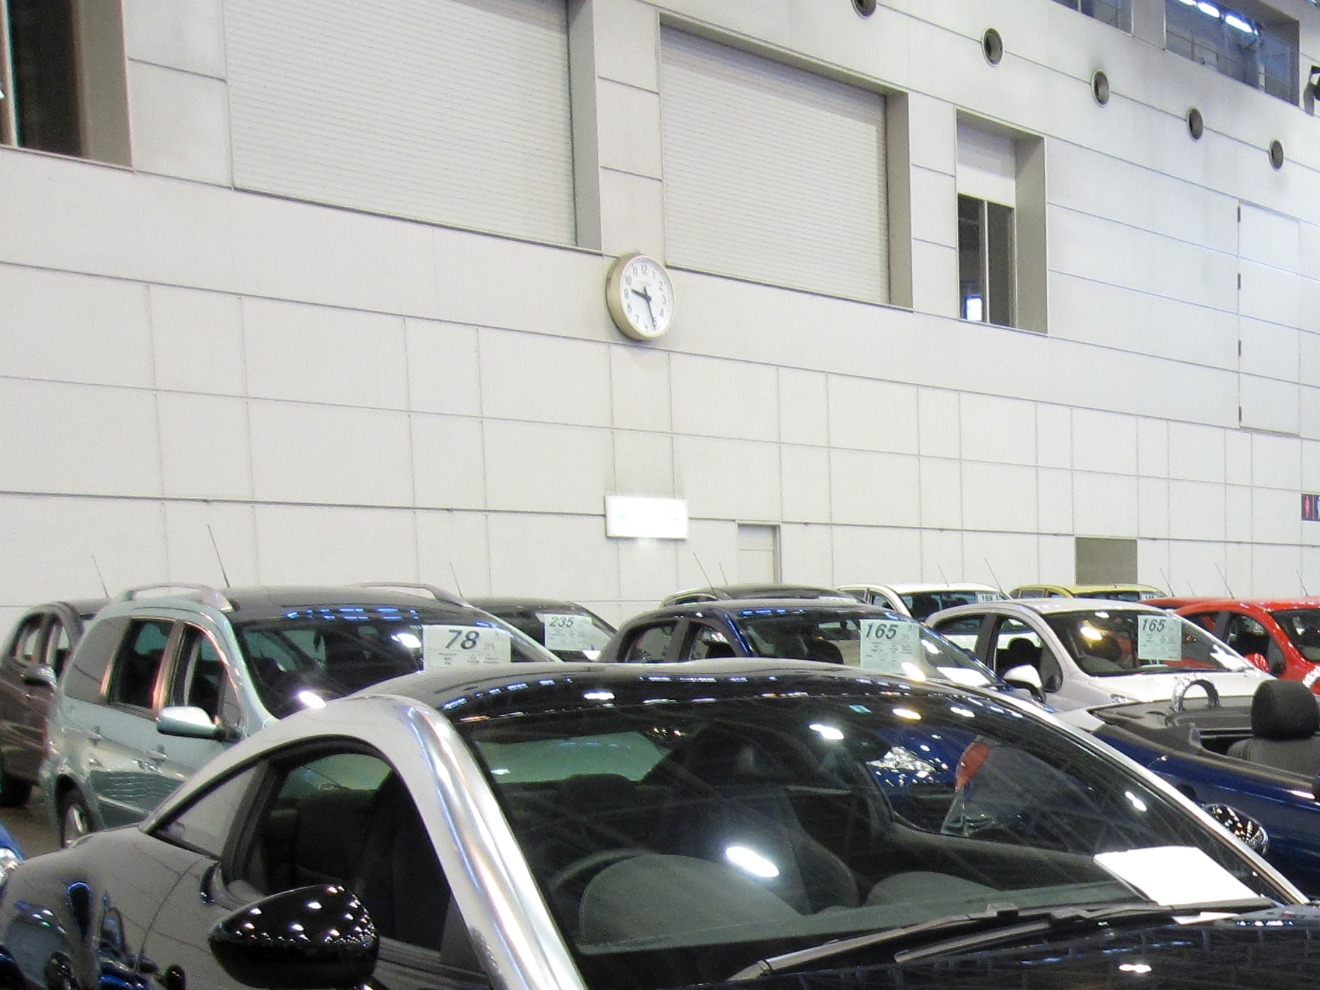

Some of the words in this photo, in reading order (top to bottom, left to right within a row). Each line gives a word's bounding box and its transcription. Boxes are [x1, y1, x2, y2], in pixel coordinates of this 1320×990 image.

[549, 615, 575, 628] 235
[1141, 618, 1167, 633] 165
[865, 622, 899, 640] 165
[445, 629, 480, 650] 78
